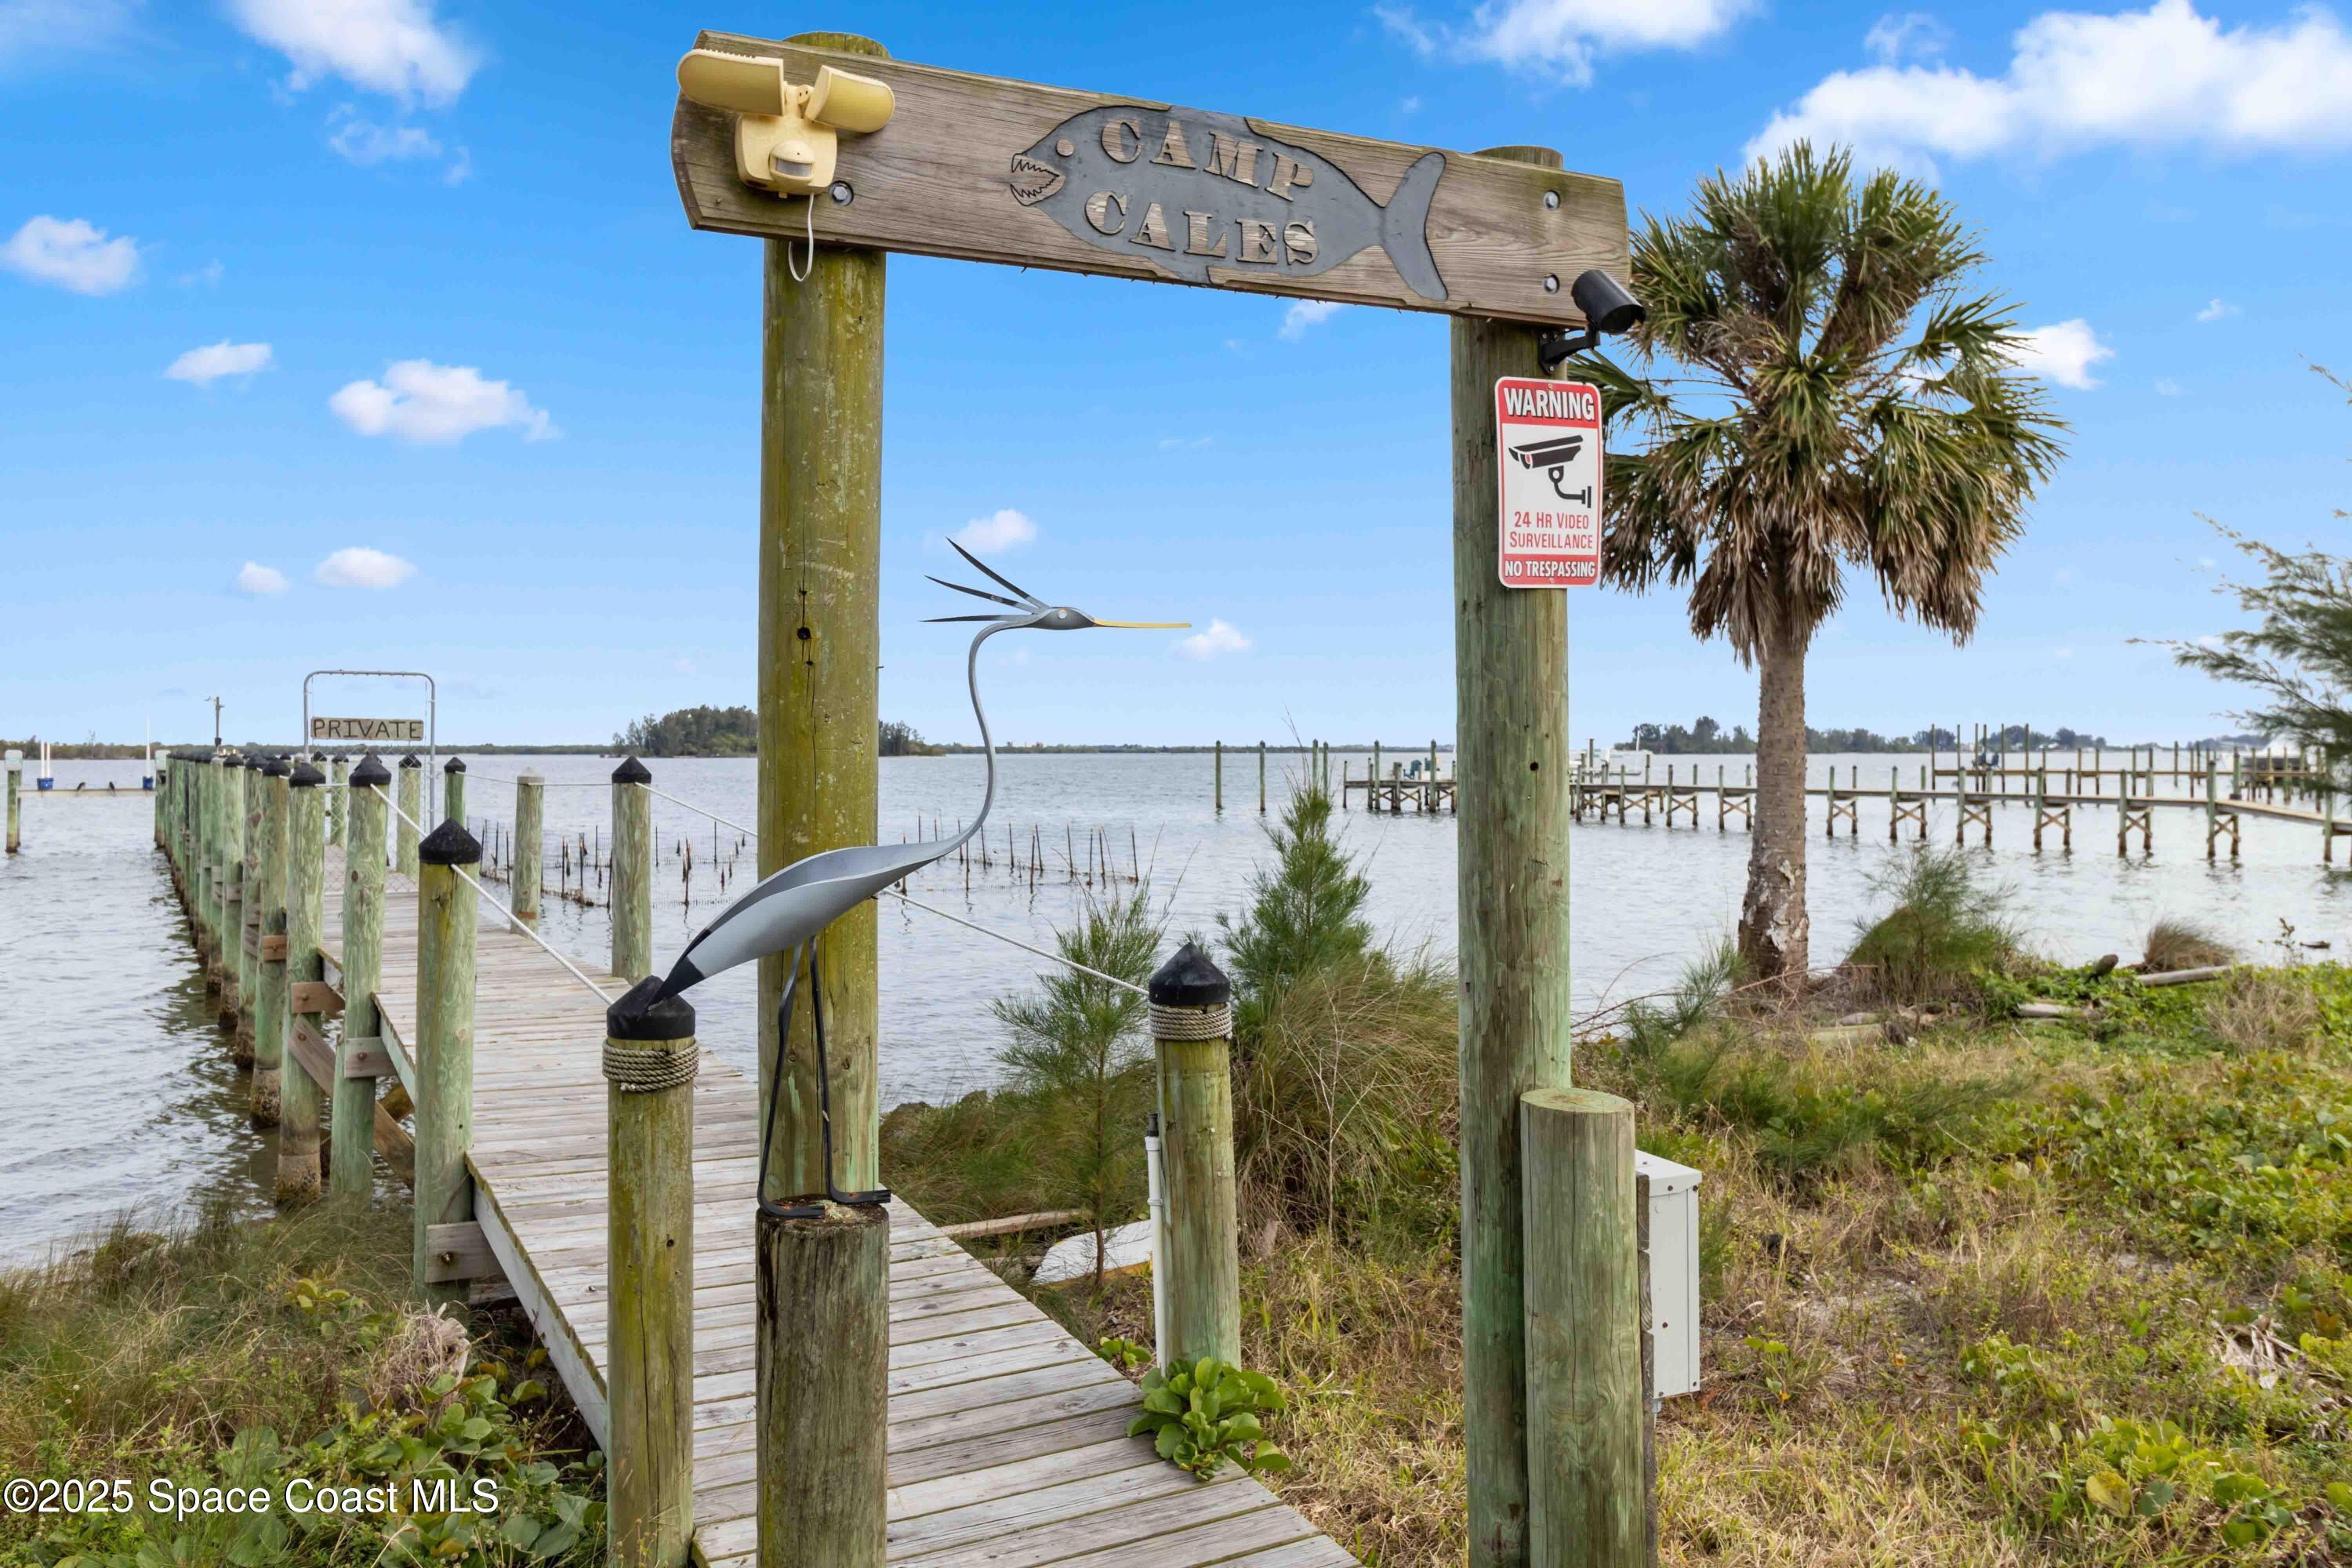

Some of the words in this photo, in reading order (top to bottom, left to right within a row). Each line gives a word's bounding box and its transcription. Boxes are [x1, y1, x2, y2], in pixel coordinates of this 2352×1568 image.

[1100, 118, 1315, 201] CAMP
[1084, 190, 1319, 266] CALES
[1503, 387, 1595, 421] WARNING
[1514, 511, 1531, 528] 24
[1536, 512, 1552, 529] HR
[1557, 513, 1589, 530] VIDEO
[1509, 531, 1593, 550] SURVEILLANCE
[1504, 561, 1523, 578] NO
[1526, 561, 1595, 579] TRESPASSING
[313, 718, 424, 739] PRIVATE
